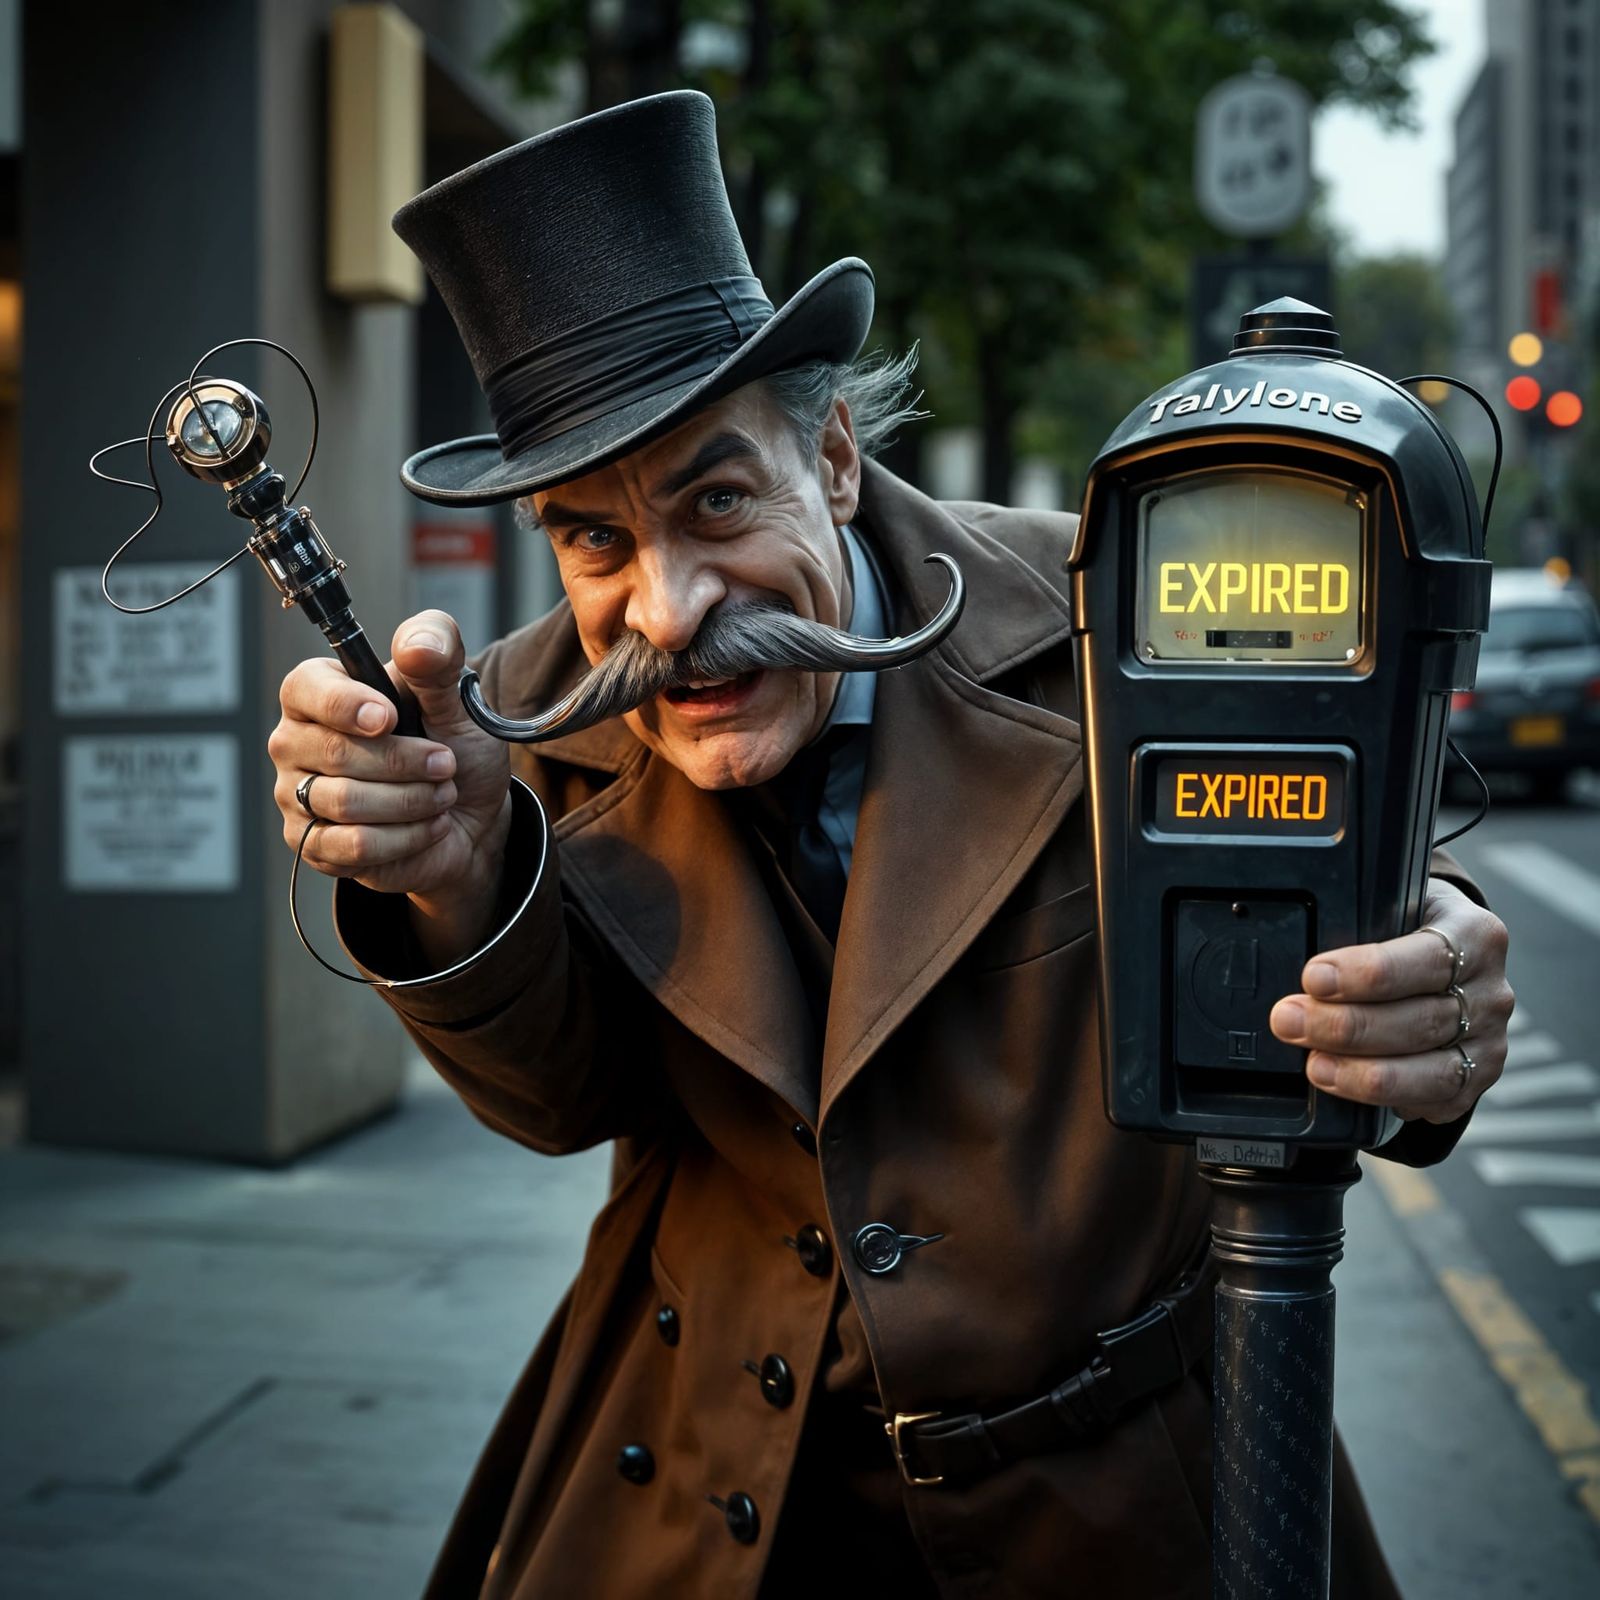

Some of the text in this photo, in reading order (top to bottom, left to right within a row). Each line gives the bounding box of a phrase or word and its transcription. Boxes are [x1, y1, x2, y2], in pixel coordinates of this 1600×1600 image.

[1150, 381, 1362, 423] Talylone
[1159, 562, 1350, 614] EXPIRED
[1176, 773, 1327, 820] EXPIRED
